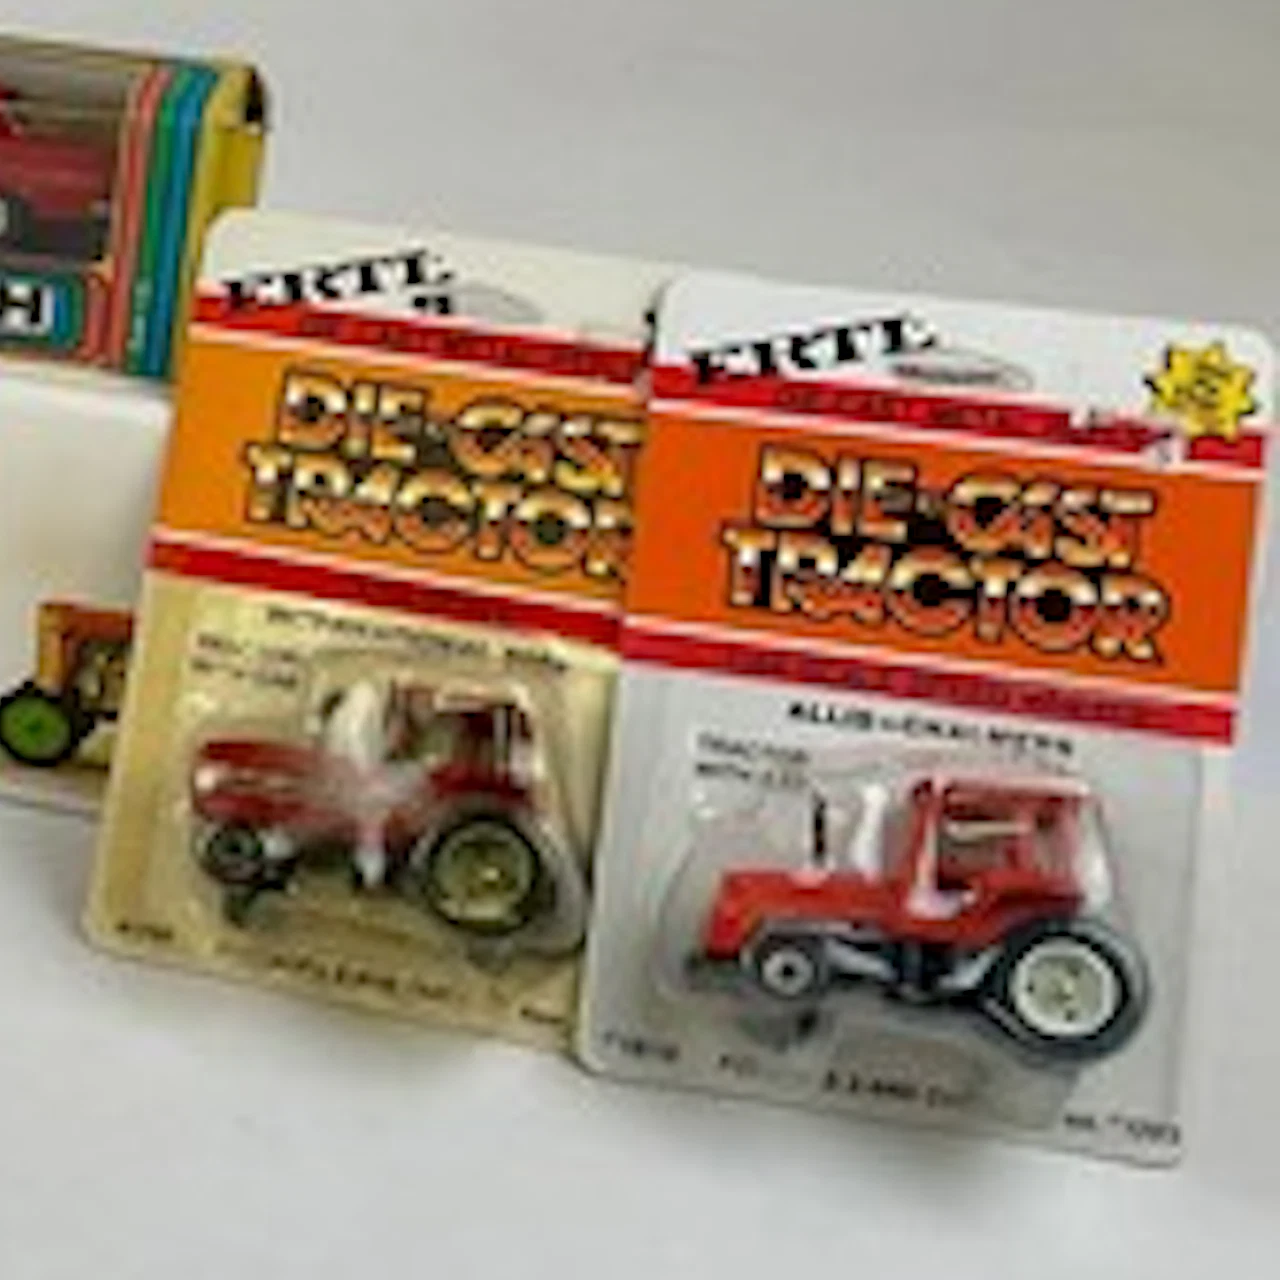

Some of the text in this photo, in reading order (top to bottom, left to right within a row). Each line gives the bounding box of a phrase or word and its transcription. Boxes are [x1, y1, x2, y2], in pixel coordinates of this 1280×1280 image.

[223, 246, 456, 312] ERTL
[688, 312, 936, 386] ERTL
[722, 520, 1175, 666] TRACTOR
